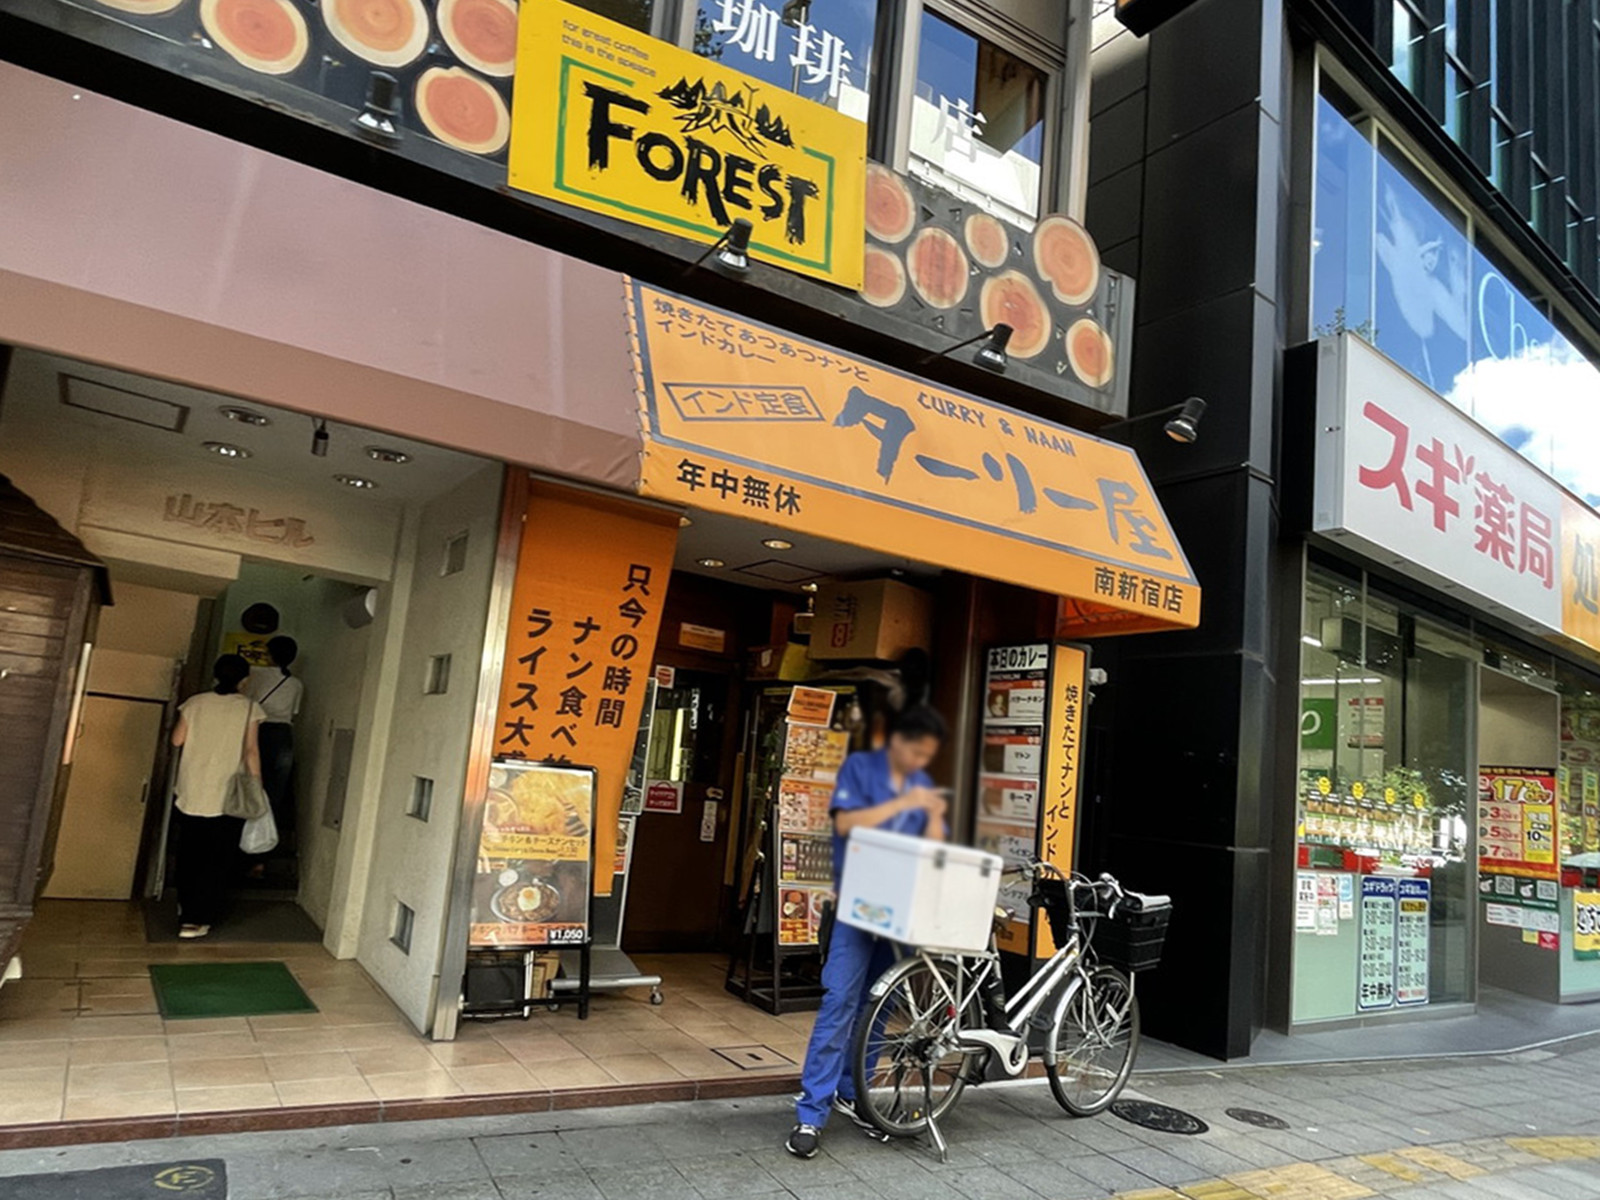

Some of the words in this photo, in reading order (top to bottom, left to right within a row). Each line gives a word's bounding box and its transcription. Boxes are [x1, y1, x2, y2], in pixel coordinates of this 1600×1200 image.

[562, 35, 582, 48] this
[597, 48, 614, 60] the
[563, 20, 578, 32] for
[614, 41, 650, 60] coffee
[582, 81, 819, 246] FOREST
[652, 297, 870, 383] 焼きたてあつあつナンと
[656, 318, 777, 364] インドカレー
[682, 390, 812, 417] インド定食
[916, 391, 986, 429] CURRY
[1000, 416, 1015, 437] &
[1026, 425, 1077, 458] NAAN
[676, 458, 802, 516] 年中無休
[832, 385, 1173, 561] ターリー屋
[1358, 400, 1554, 591] スギ薬局
[1093, 566, 1184, 614] 南新宿店
[594, 563, 652, 729] 只今の時間
[990, 646, 1047, 670] 本日のカレー
[498, 608, 553, 761] ライス大
[1058, 683, 1079, 819] 焼きたてナンと
